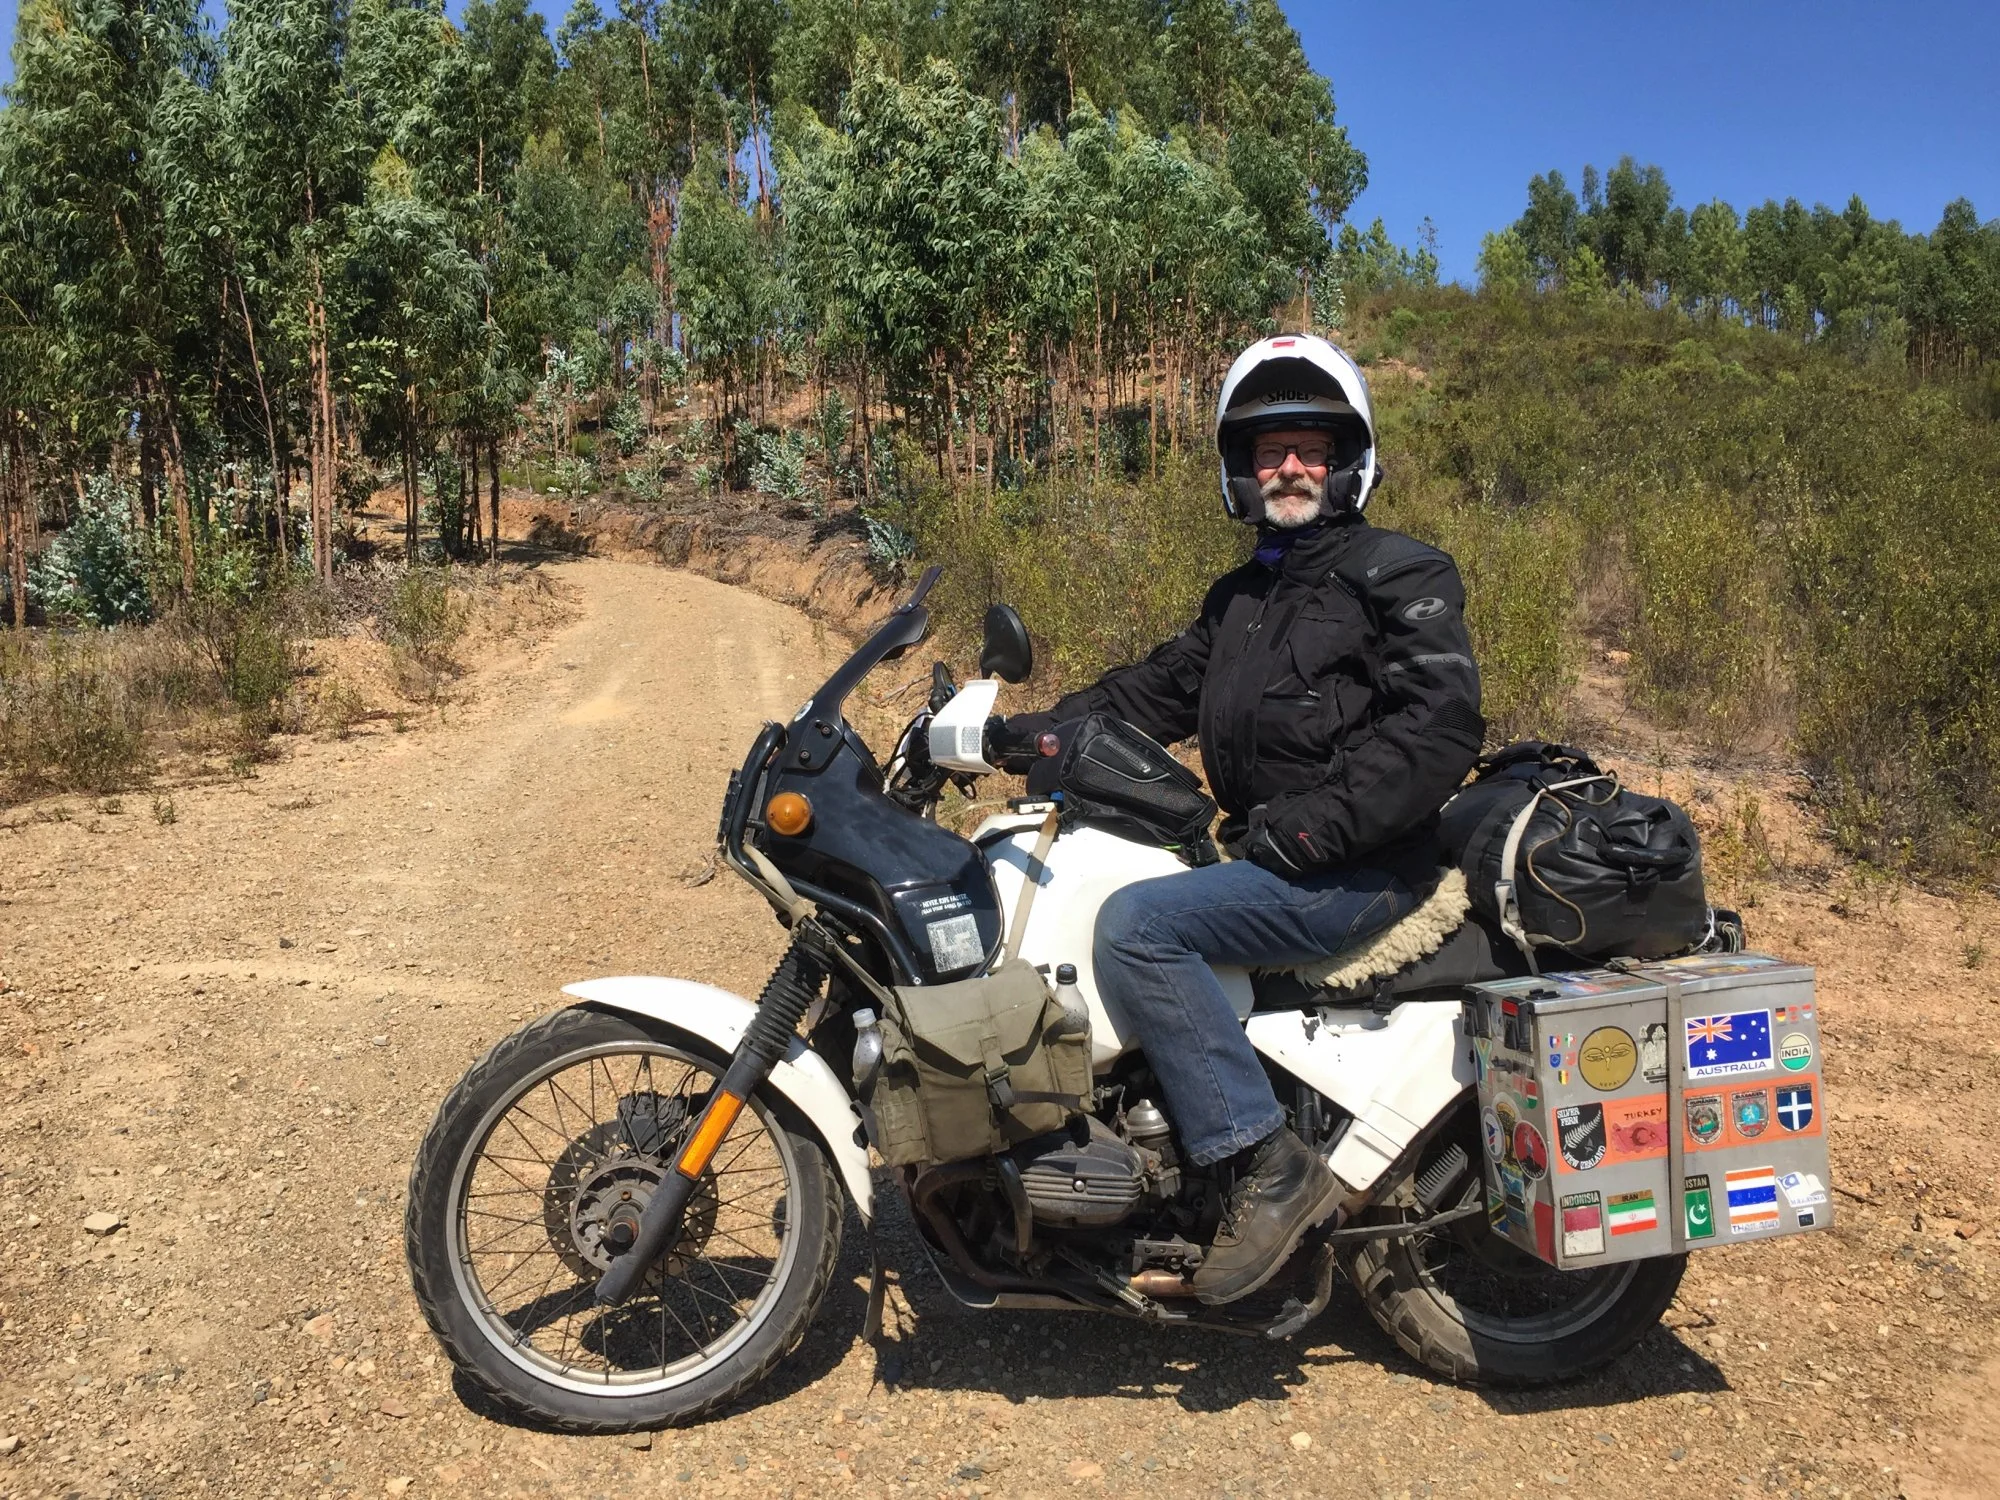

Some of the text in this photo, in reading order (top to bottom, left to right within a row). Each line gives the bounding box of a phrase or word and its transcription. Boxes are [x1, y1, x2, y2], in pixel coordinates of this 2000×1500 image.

[1267, 388, 1309, 403] SHOEI
[1781, 1047, 1810, 1058] INDIA
[1696, 1061, 1767, 1077] AUSTRALIA
[1557, 1107, 1580, 1119] SILVER
[1624, 1107, 1662, 1120] TURKEY
[1560, 1116, 1579, 1127] FERN
[1563, 1145, 1606, 1170] NEW ZEALAND
[1685, 1177, 1707, 1188] ISTAN
[1622, 1193, 1639, 1202] IRAN
[1732, 1220, 1779, 1232] THAILAND
